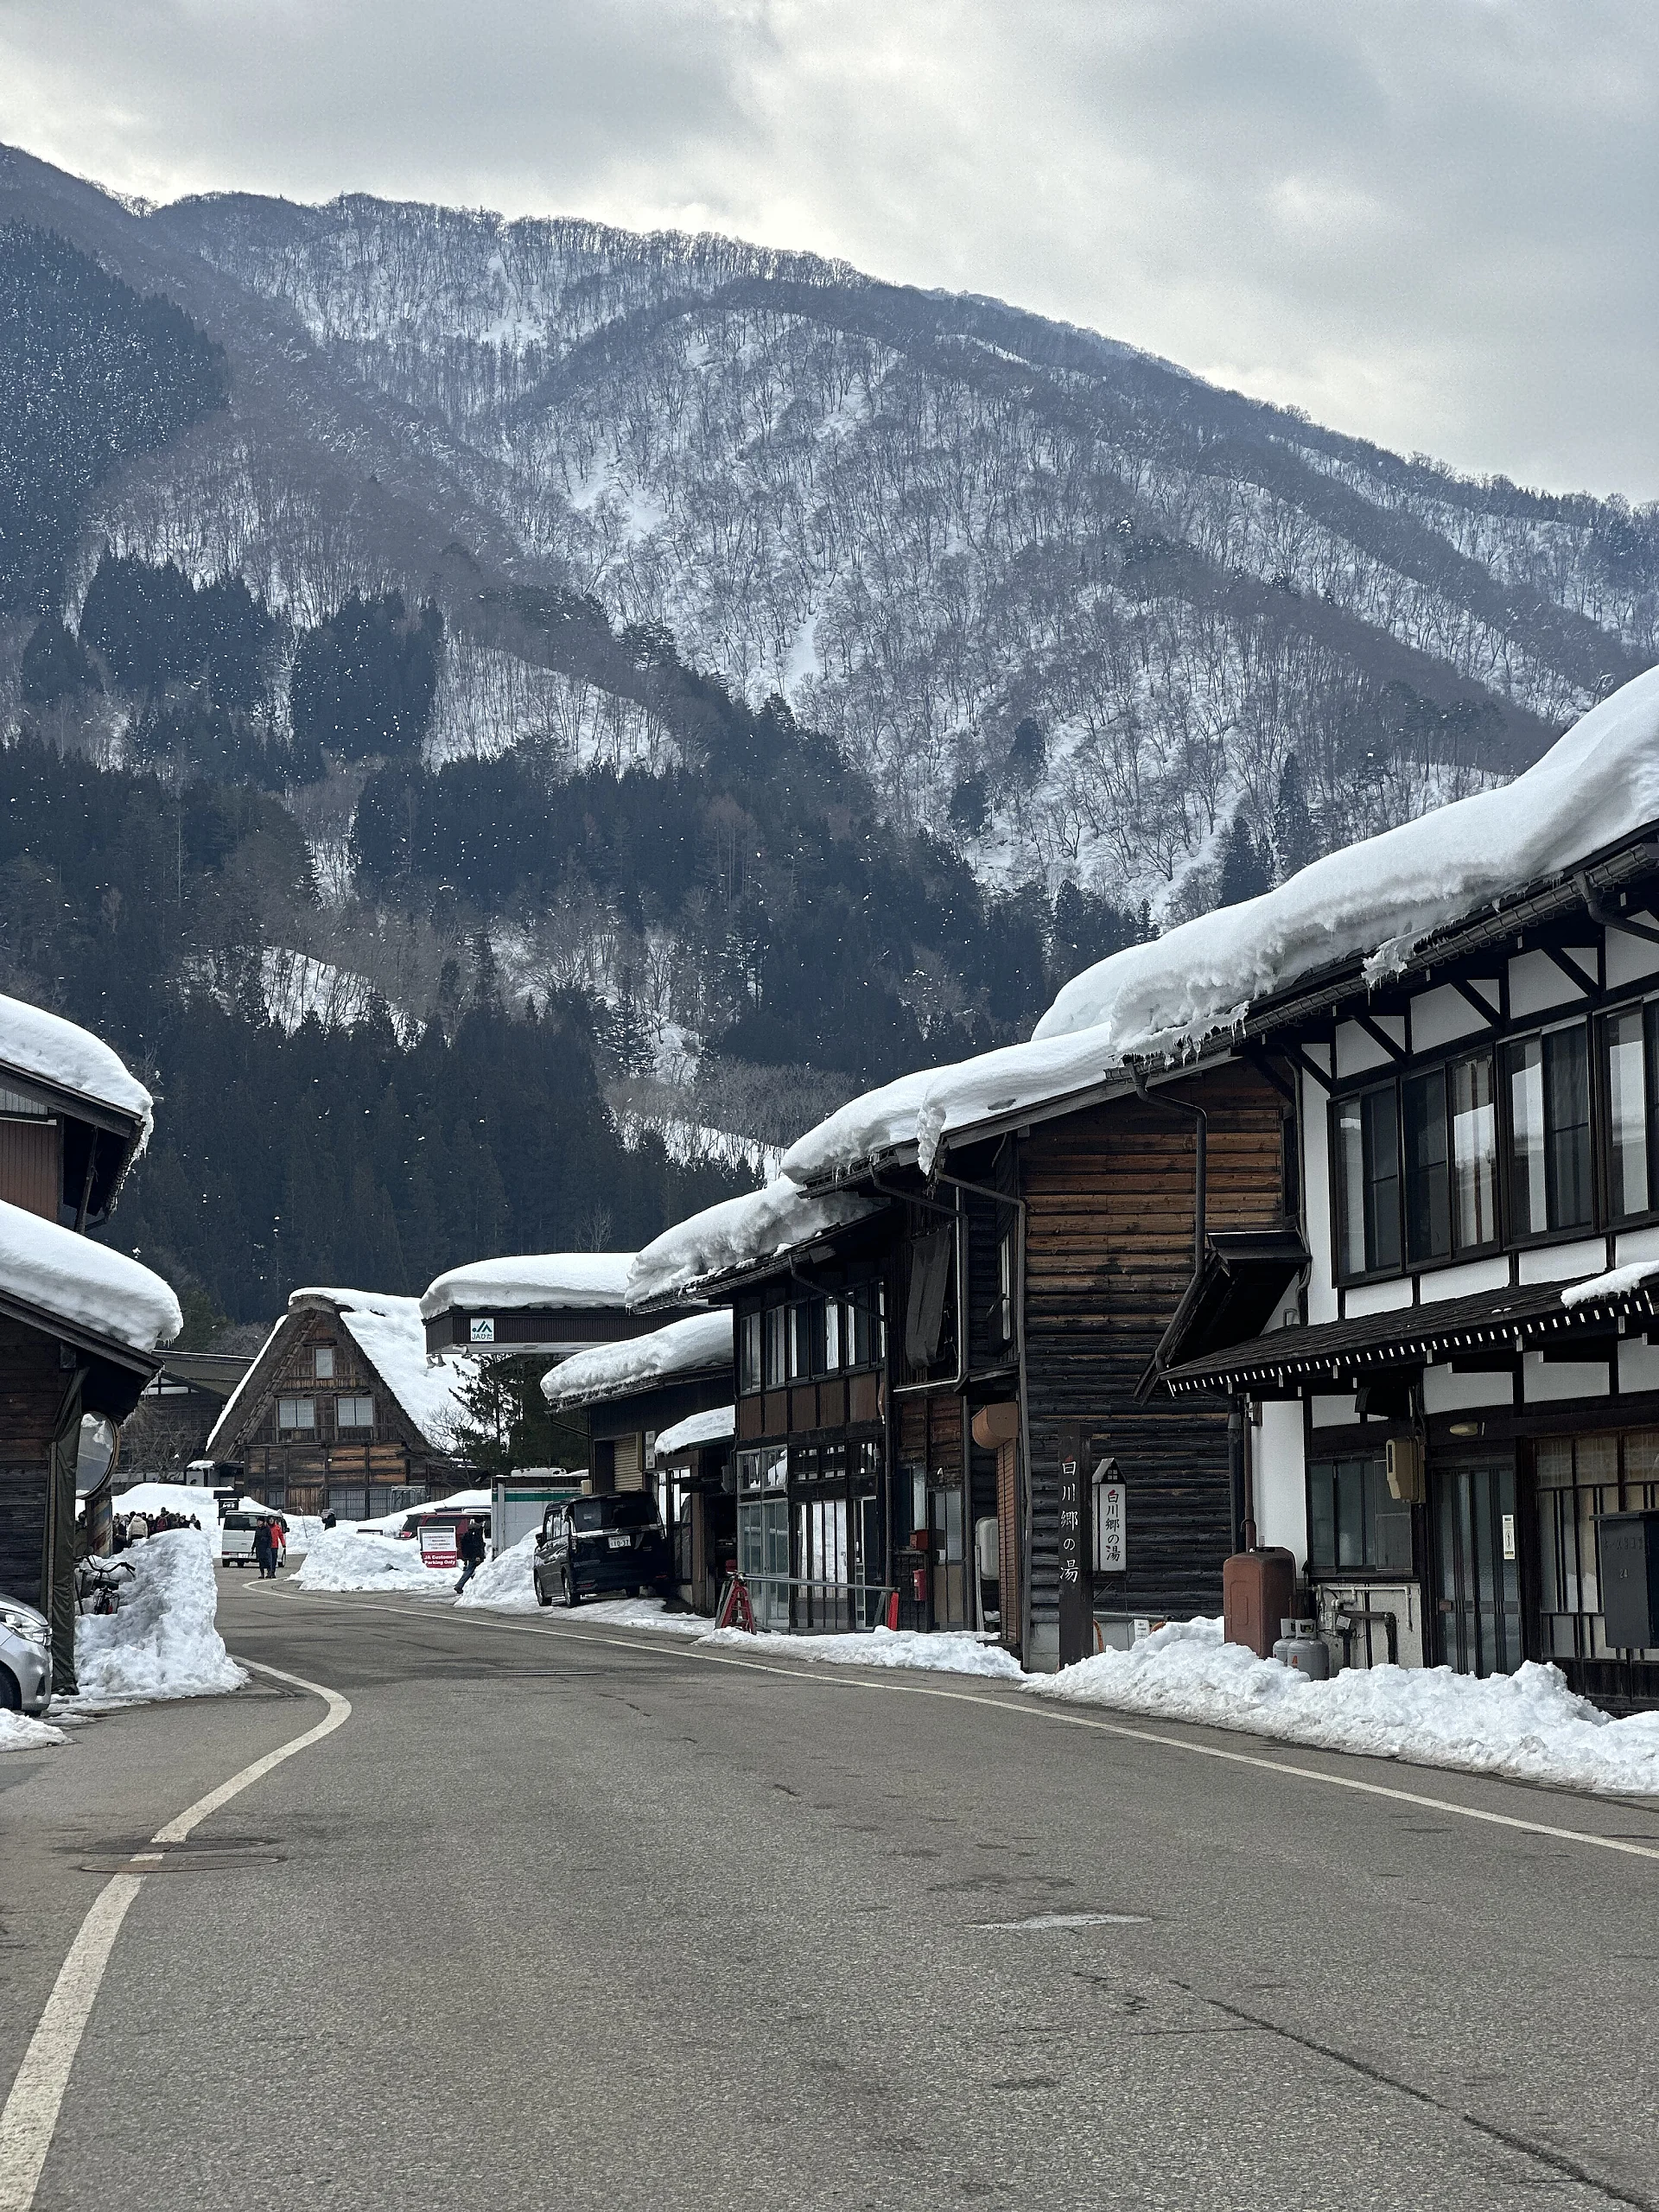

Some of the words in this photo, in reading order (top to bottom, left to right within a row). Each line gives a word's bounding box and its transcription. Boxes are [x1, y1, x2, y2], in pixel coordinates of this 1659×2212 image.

[1059, 1455, 1079, 1583] 白川郷の湯
[1105, 1490, 1121, 1561] 白川郷の湯
